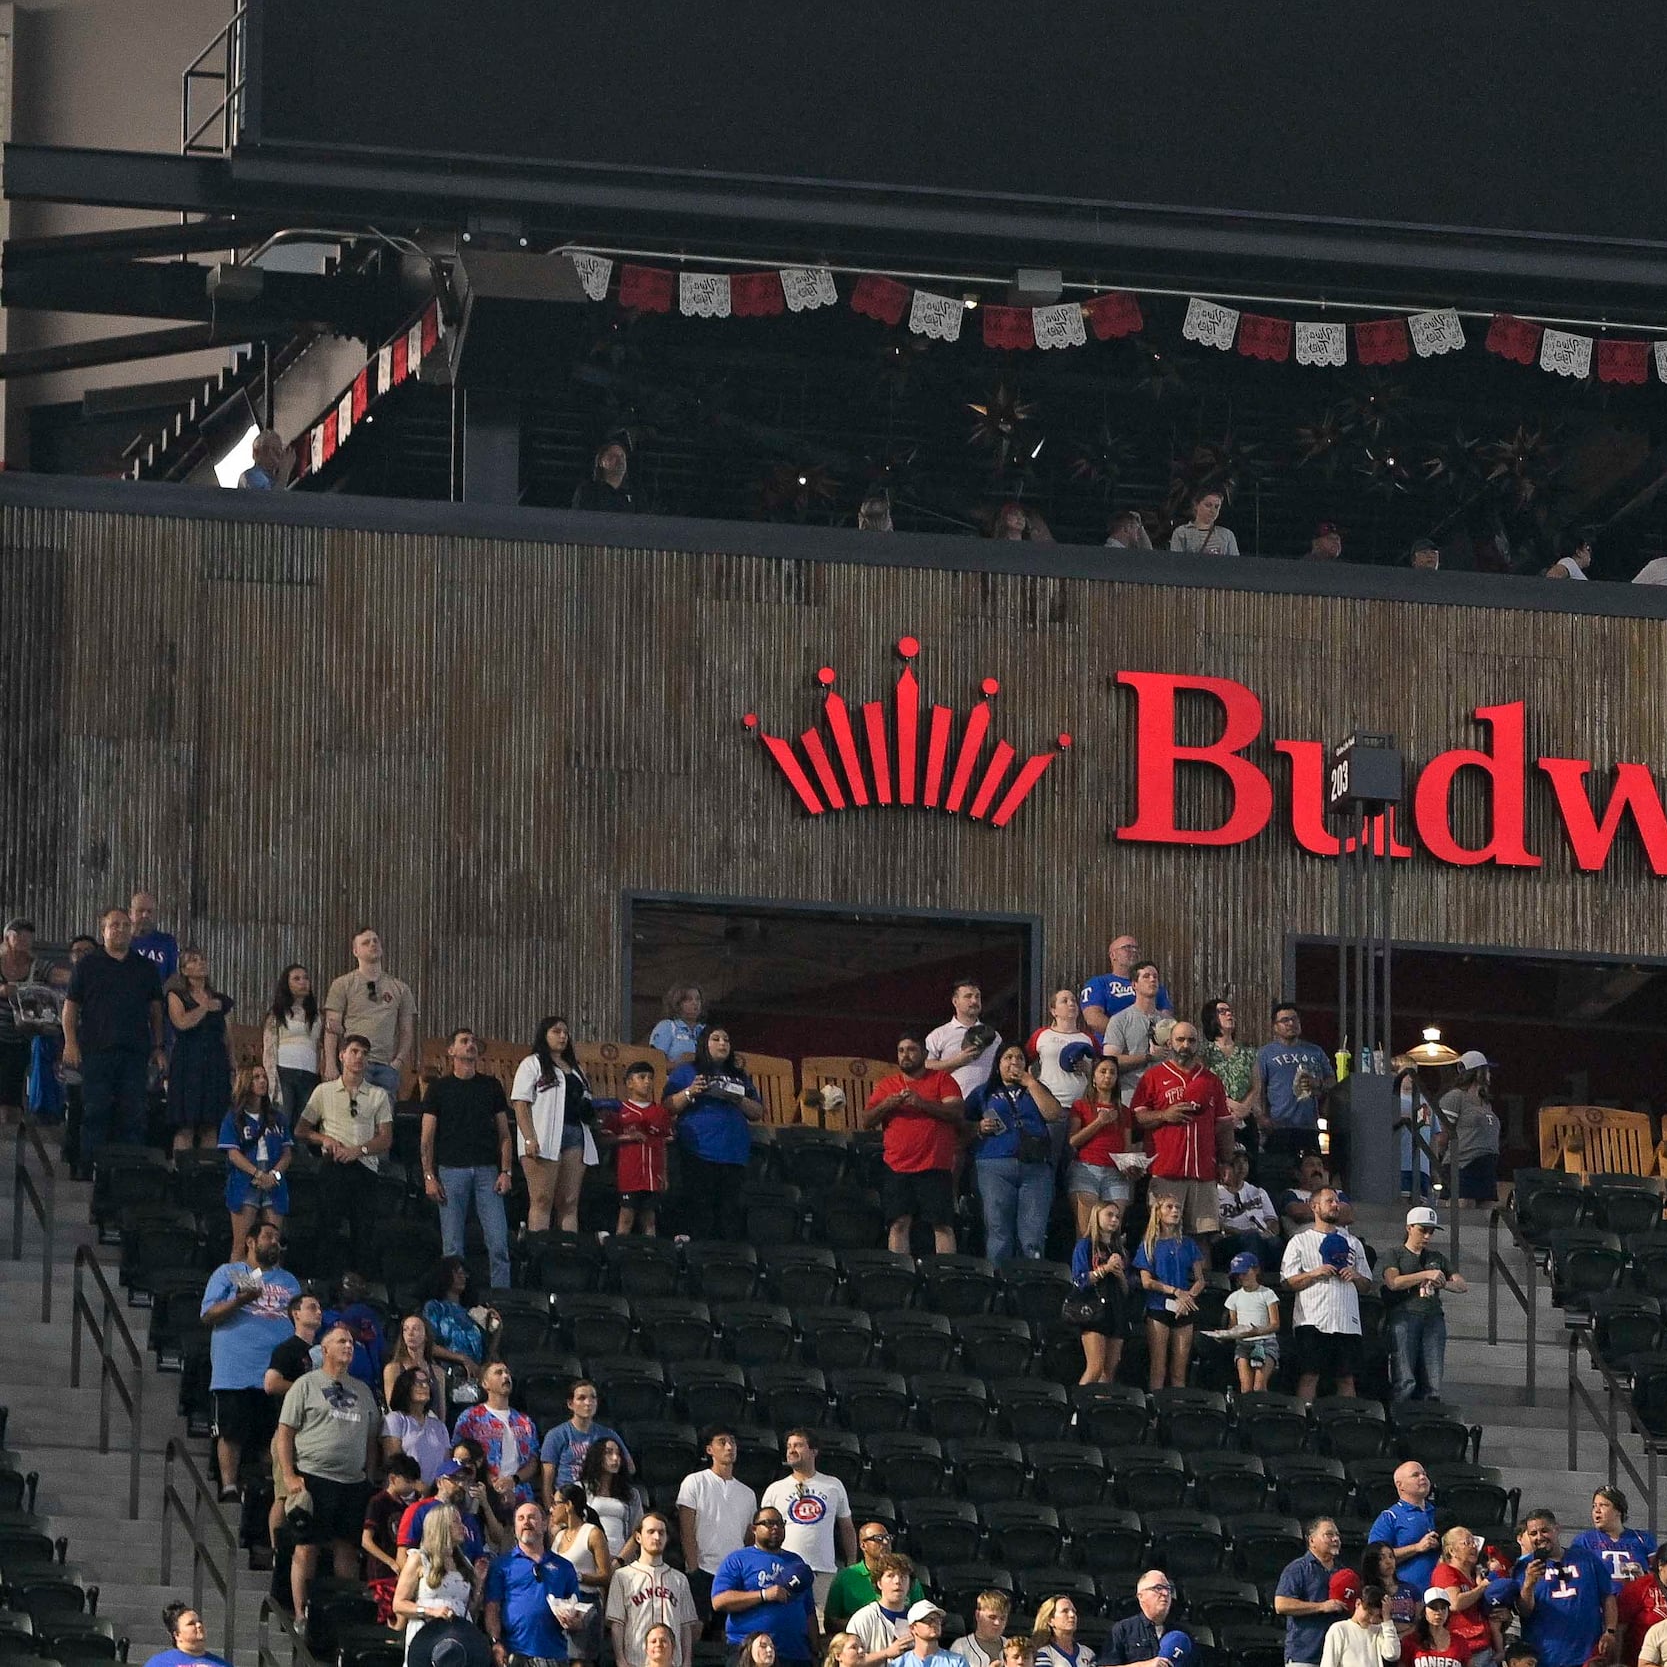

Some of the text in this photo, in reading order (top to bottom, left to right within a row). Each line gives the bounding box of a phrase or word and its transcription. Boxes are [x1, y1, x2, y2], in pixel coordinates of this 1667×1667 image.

[1331, 760, 1348, 802] 203
[1081, 986, 1092, 1003] T
[1601, 1550, 1631, 1580] T
[789, 1574, 801, 1587] T
[1344, 1587, 1355, 1600] T
[1172, 1647, 1184, 1659] T
